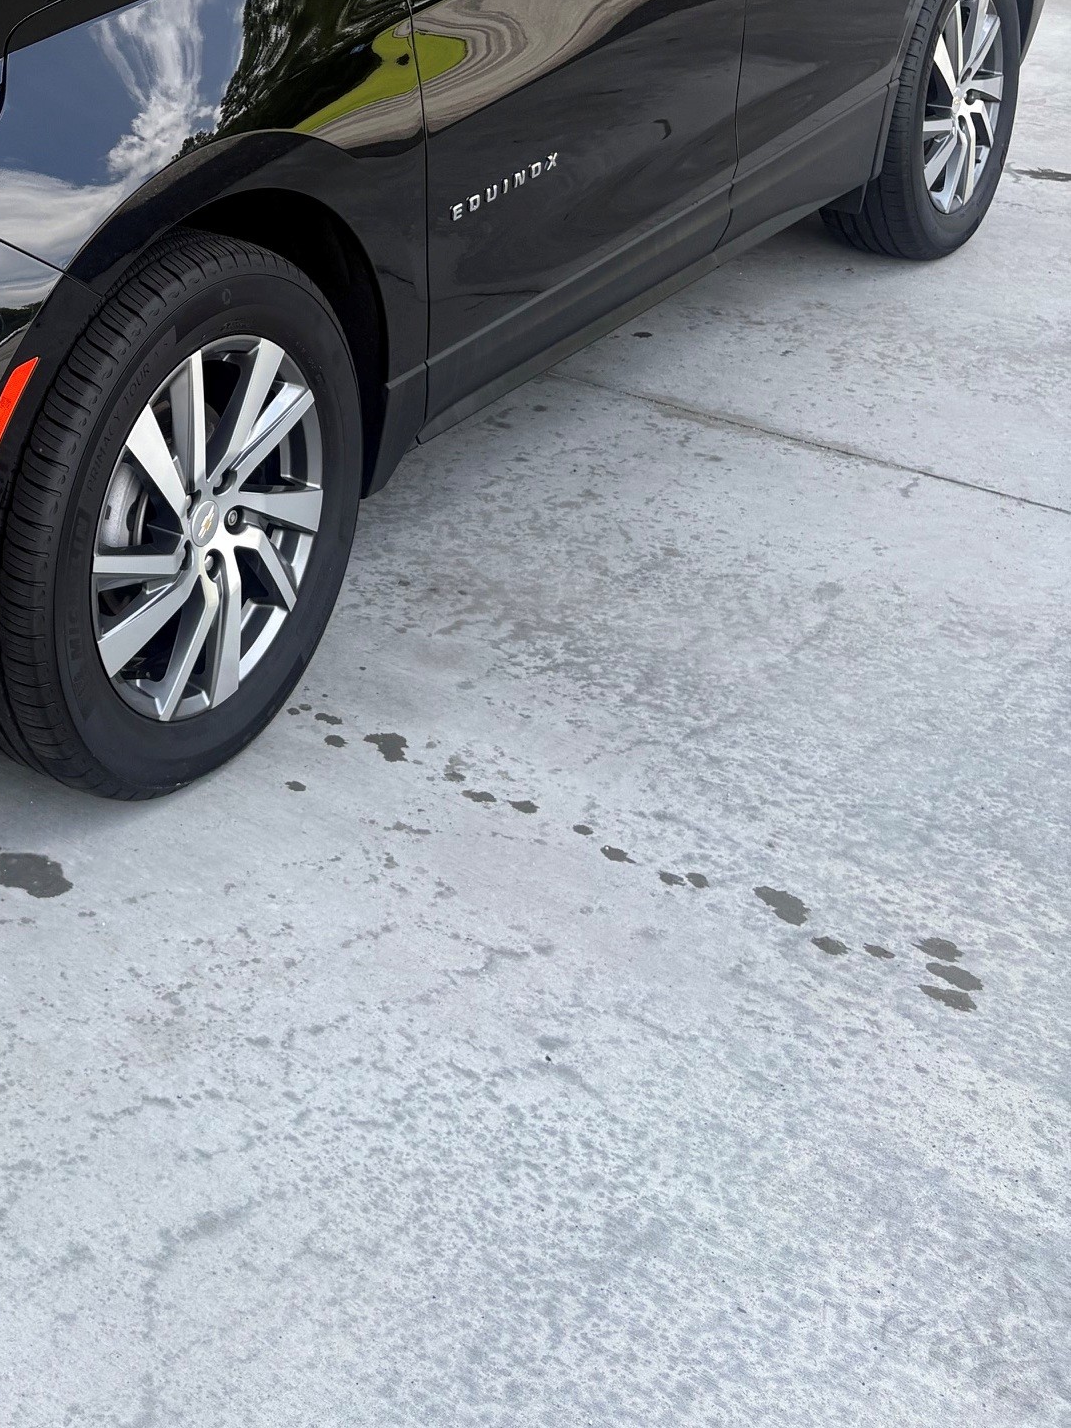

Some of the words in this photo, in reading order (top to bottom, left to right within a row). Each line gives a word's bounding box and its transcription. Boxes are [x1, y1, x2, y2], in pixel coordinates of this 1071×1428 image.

[446, 151, 559, 222] EQUINOX
[86, 412, 123, 492] PRIMACY
[122, 362, 151, 405] TOUR
